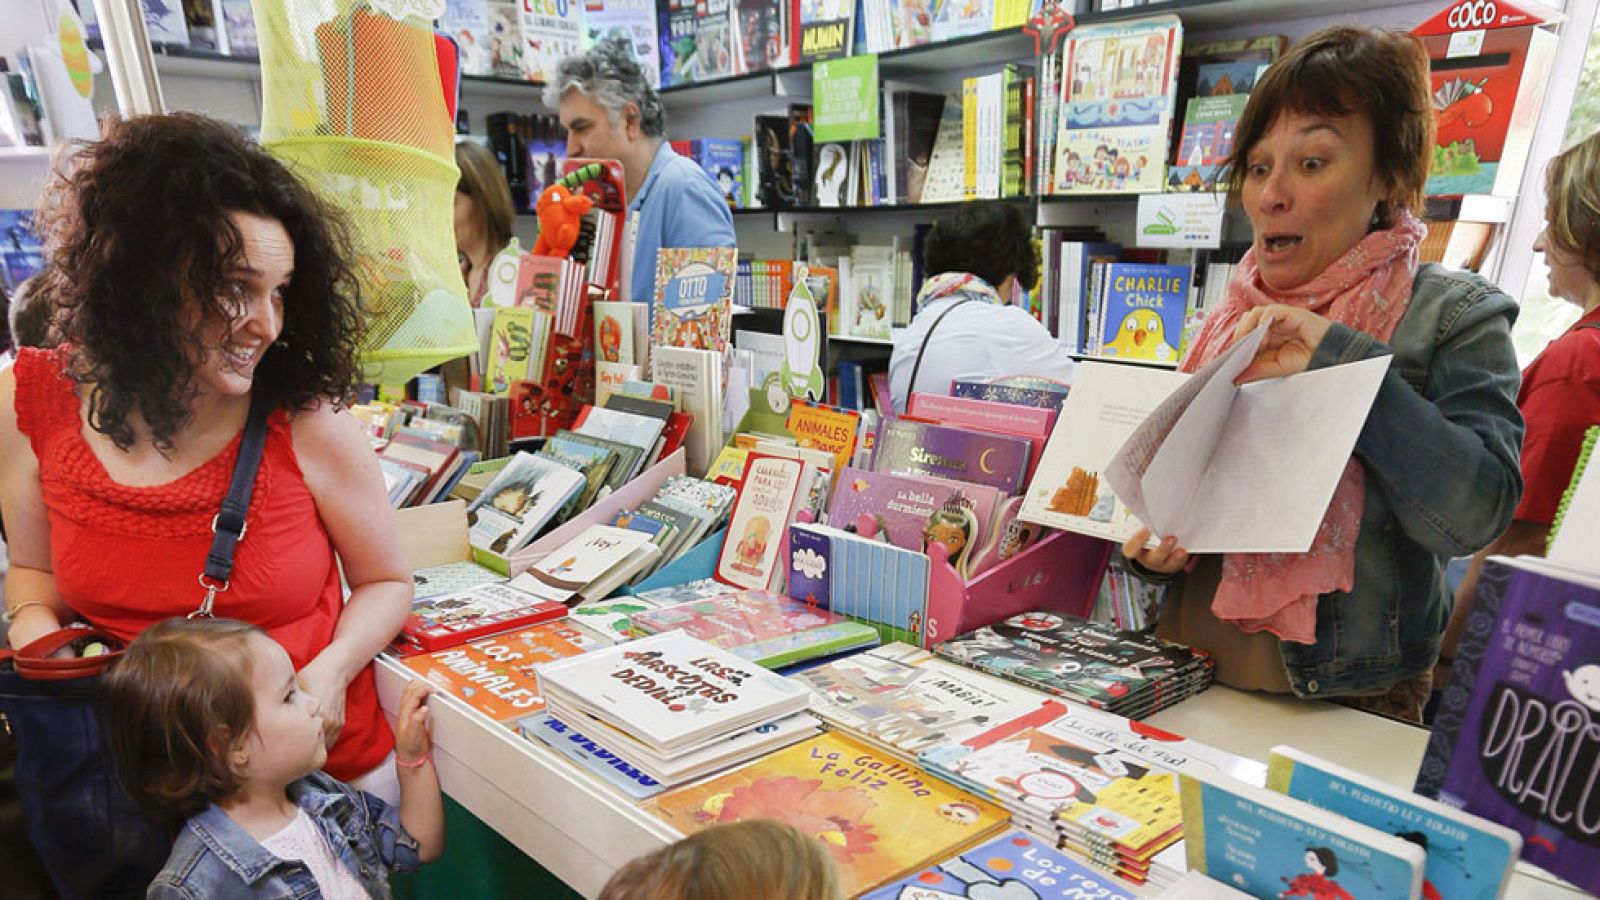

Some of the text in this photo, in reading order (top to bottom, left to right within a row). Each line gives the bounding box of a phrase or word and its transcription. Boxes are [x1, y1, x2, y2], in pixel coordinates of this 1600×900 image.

[1448, 0, 1496, 28] COCO
[679, 276, 708, 298] OTTO
[1114, 275, 1181, 294] CHARLIE
[1126, 293, 1165, 308] Chick
[795, 418, 849, 443] ANIMALES
[471, 639, 523, 663] LOS
[431, 649, 545, 709] ANIMALES
[689, 657, 735, 679] LAS
[811, 747, 931, 797] La Gallina
[820, 762, 888, 791] Feliz
[1022, 847, 1068, 875] Los
[1022, 868, 1057, 887] de
